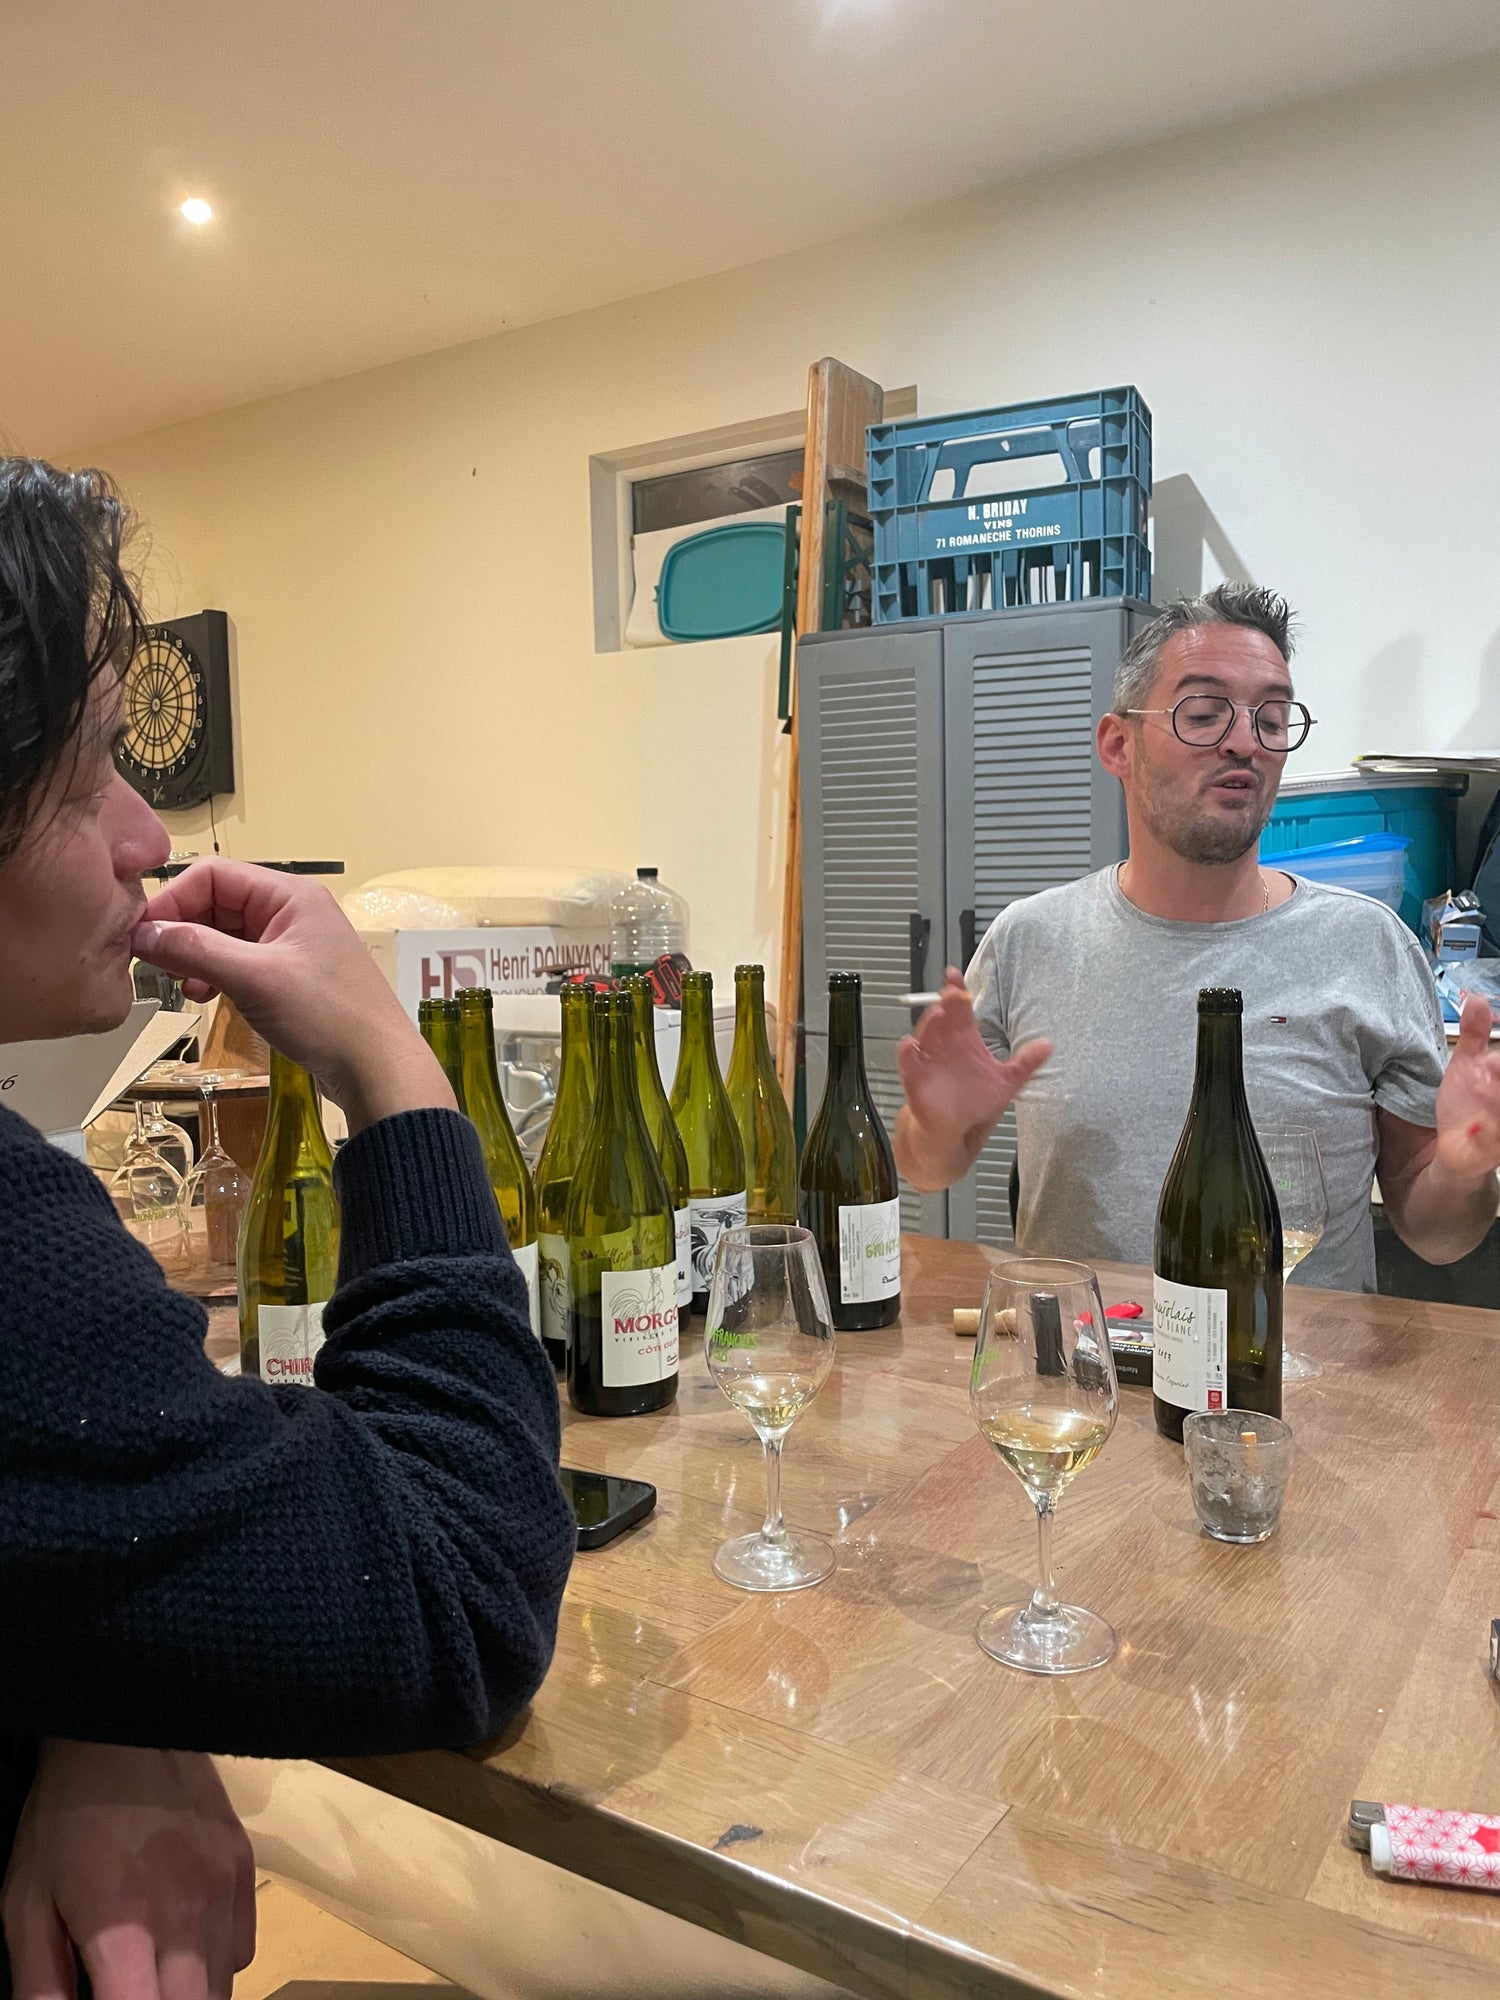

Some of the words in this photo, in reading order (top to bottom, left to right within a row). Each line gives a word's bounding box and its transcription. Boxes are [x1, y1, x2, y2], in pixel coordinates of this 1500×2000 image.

[983, 499, 1028, 518] BRIDAY
[983, 518, 1013, 530] VINS
[935, 537, 946, 549] 71
[949, 530, 1012, 547] ROMANECHE
[1015, 524, 1061, 540] THORINS
[198, 695, 203, 705] 6
[129, 759, 134, 769] 7
[181, 755, 186, 765] 2
[155, 770, 160, 780] 3
[168, 765, 176, 776] 17
[490, 947, 530, 981] Henri
[613, 1304, 678, 1334] MORGO
[266, 1356, 314, 1376] CHIR
